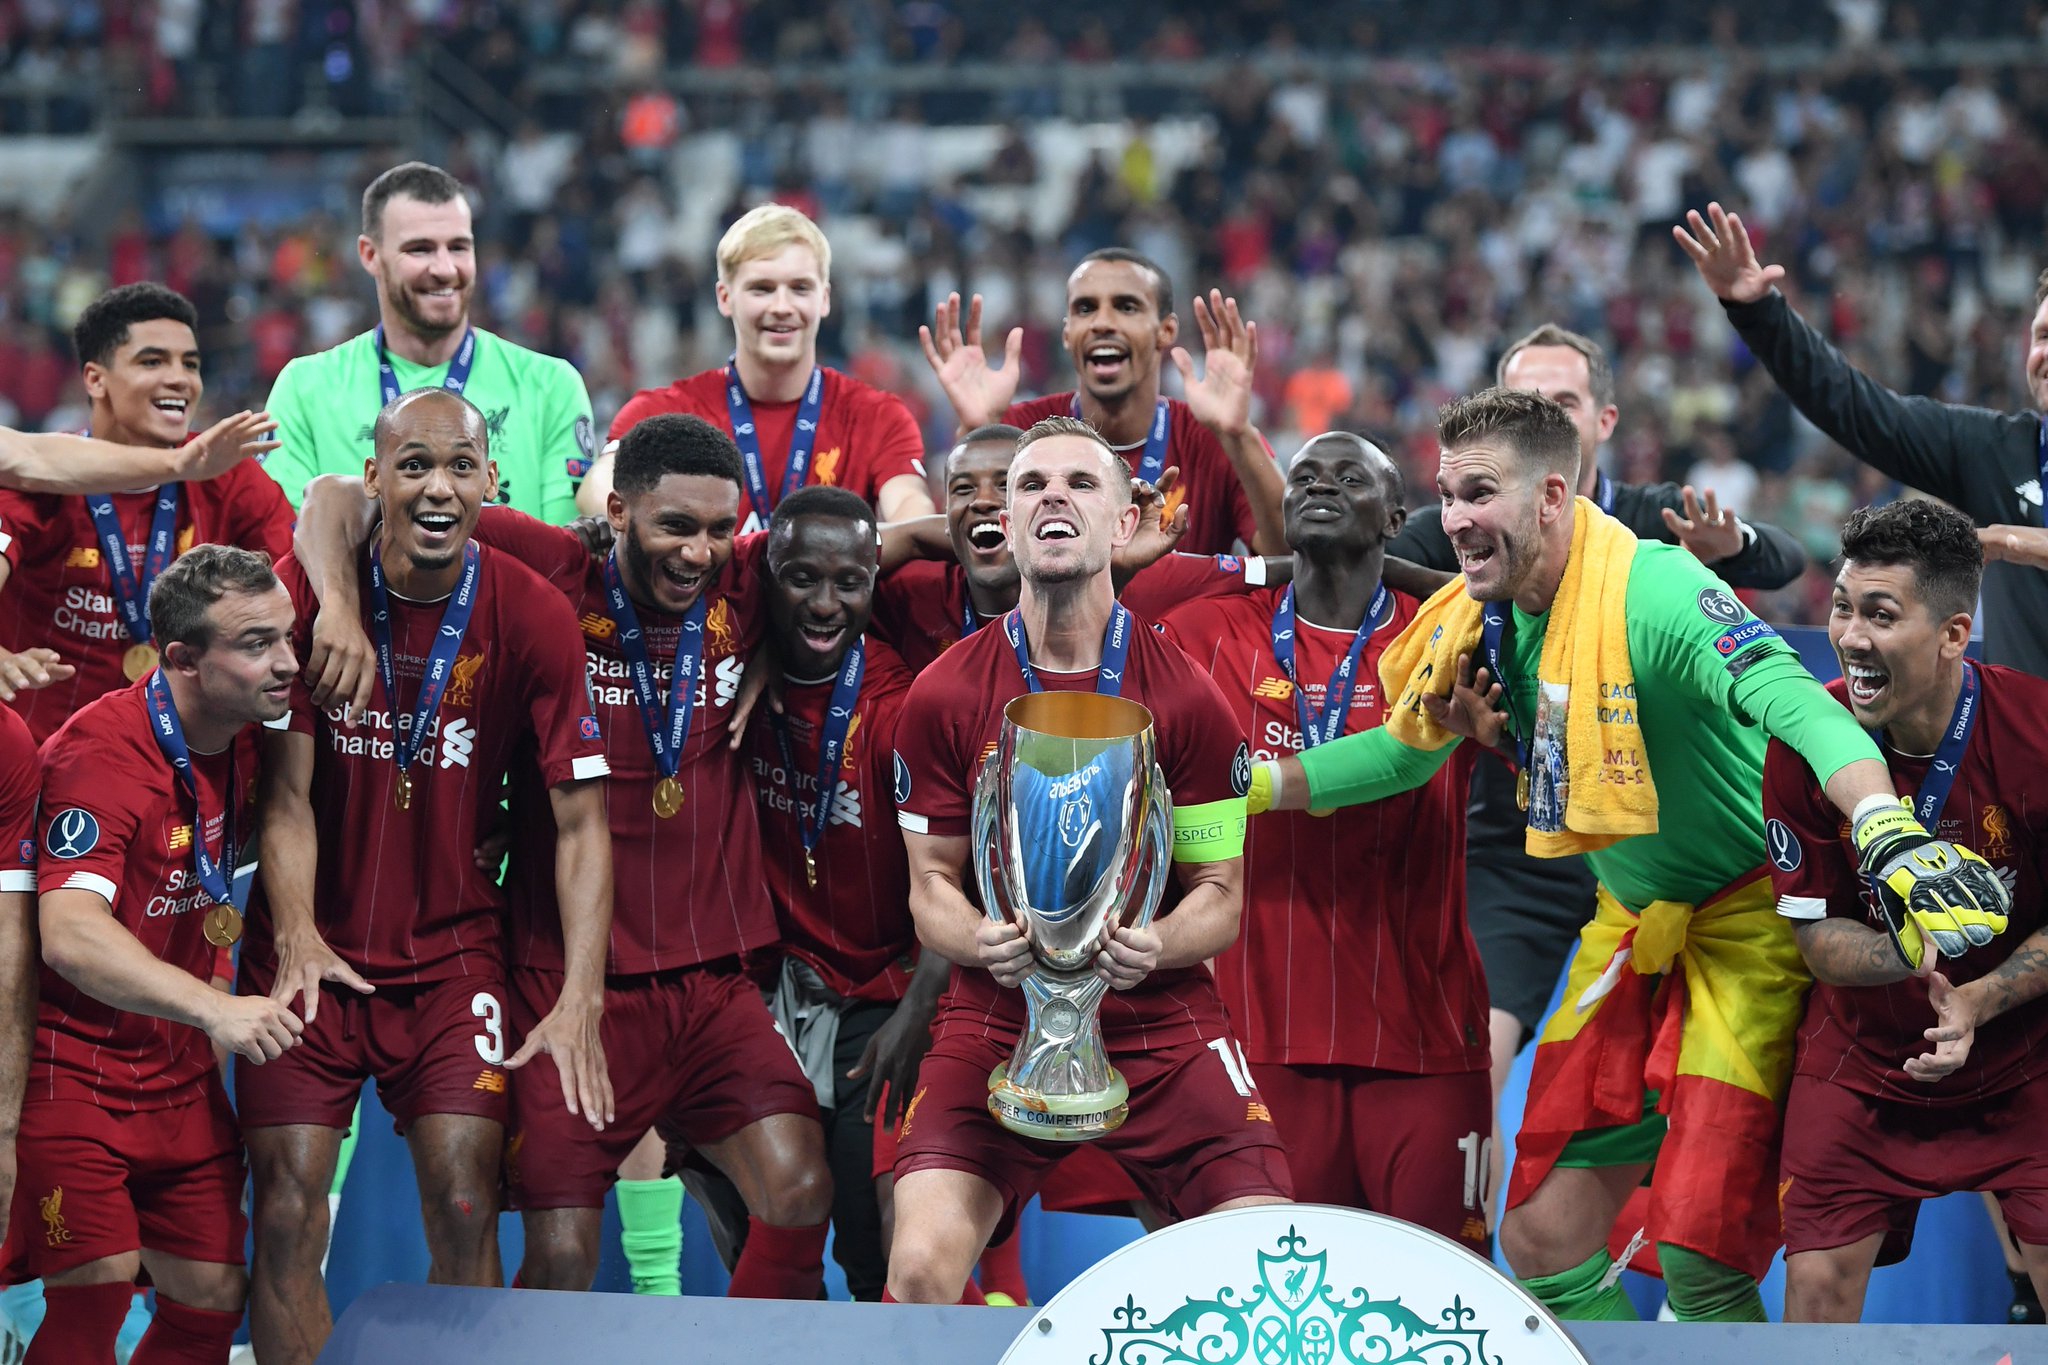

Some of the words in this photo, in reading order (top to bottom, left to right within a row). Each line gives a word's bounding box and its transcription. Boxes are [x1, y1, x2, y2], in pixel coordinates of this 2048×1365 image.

[458, 564, 475, 606] ISTANBUL
[611, 588, 625, 610] 2019
[1112, 608, 1126, 648] ISTANBUL
[1734, 623, 1775, 642] RESPEC
[431, 658, 446, 680] 2019
[681, 655, 693, 677] 2019
[636, 661, 652, 704] ISTANBUL
[1305, 684, 1328, 692] UEFA
[158, 713, 174, 736] 2019
[672, 705, 686, 748] ISTANBUL
[1325, 707, 1341, 741] TANBUL
[1953, 694, 1974, 740] ISTANBUL
[410, 709, 429, 751] ISTANBUL
[1264, 721, 1306, 749] Sta
[652, 732, 664, 755] 2019
[1920, 794, 1937, 818] 2019
[1175, 825, 1224, 841] ESPECT
[200, 854, 212, 877] 2019
[471, 992, 504, 1066] 3
[1027, 1109, 1110, 1127] COMPETITION
